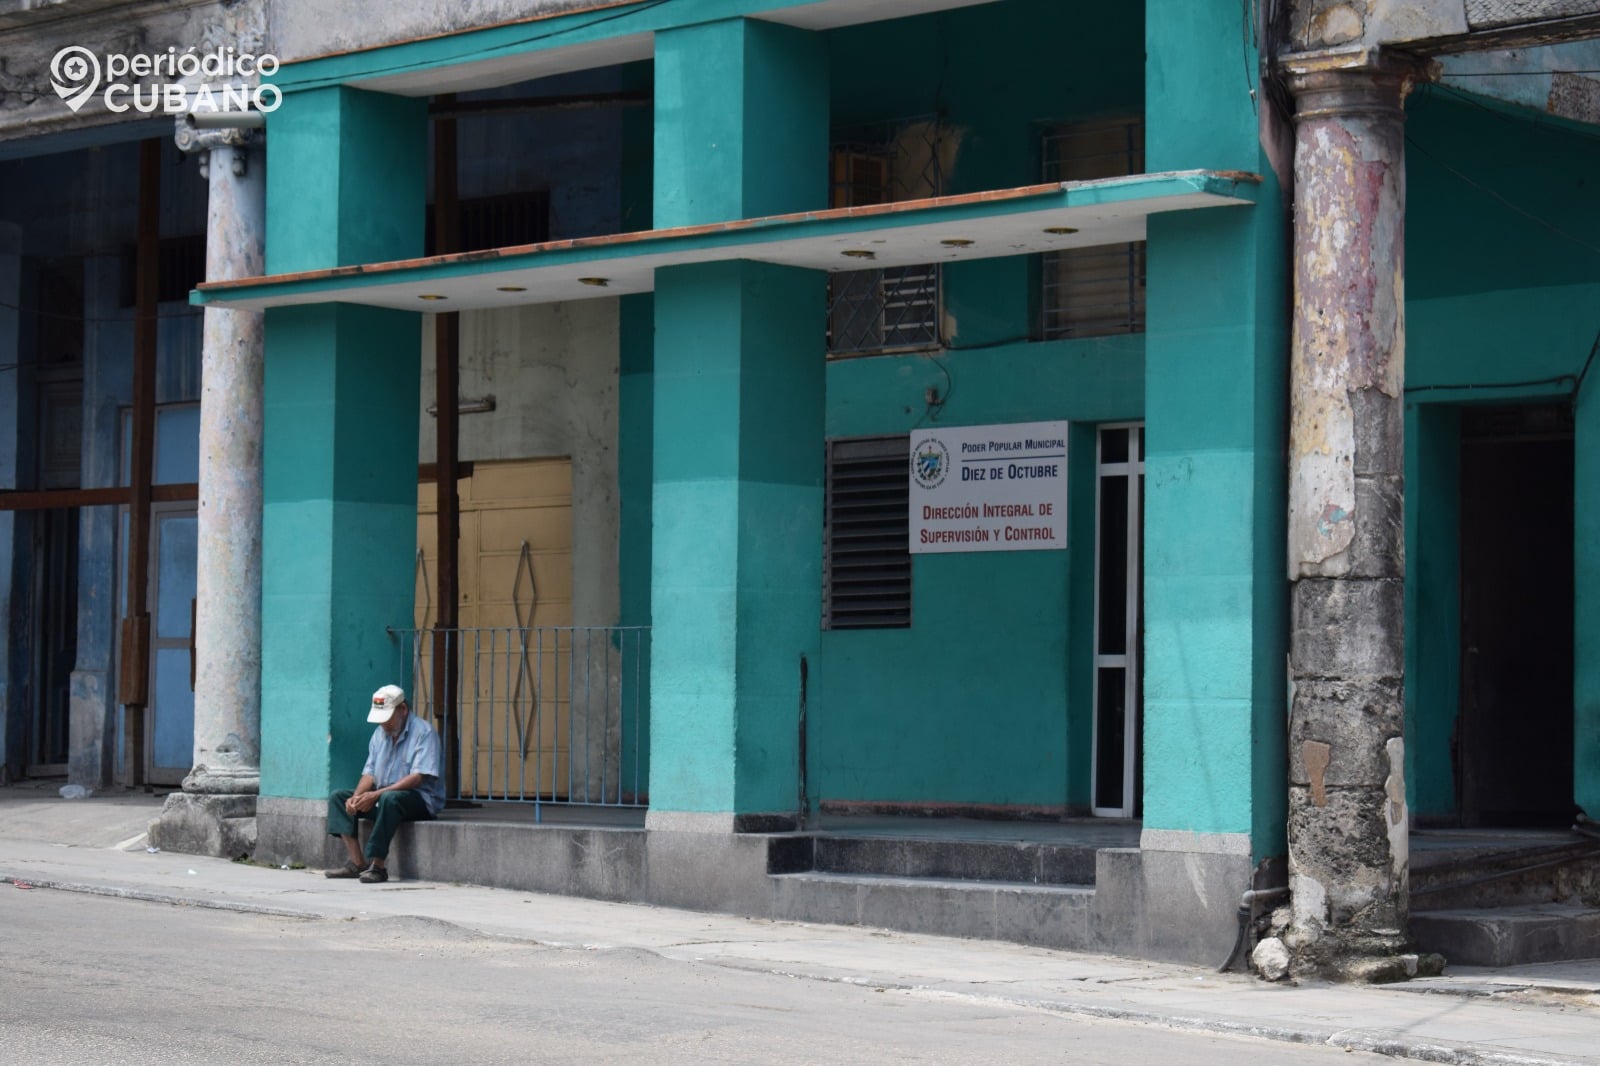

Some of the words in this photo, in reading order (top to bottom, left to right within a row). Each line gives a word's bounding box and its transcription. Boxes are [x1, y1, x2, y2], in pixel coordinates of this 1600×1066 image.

[962, 442, 985, 452] PODER
[989, 441, 1022, 451] POPULAR
[1025, 439, 1065, 449] MUNICIPAL
[962, 467, 985, 481] DIEZ
[990, 468, 1003, 479] DE
[1008, 464, 1058, 479] OCTUBRE
[923, 502, 978, 520] DIRECCIÓN
[984, 503, 1034, 518] INTEGRAL
[1039, 503, 1052, 515] DE
[920, 526, 989, 543] SUPERVISIÓN
[994, 529, 1000, 541] Y
[1005, 526, 1055, 541] CONTROL
